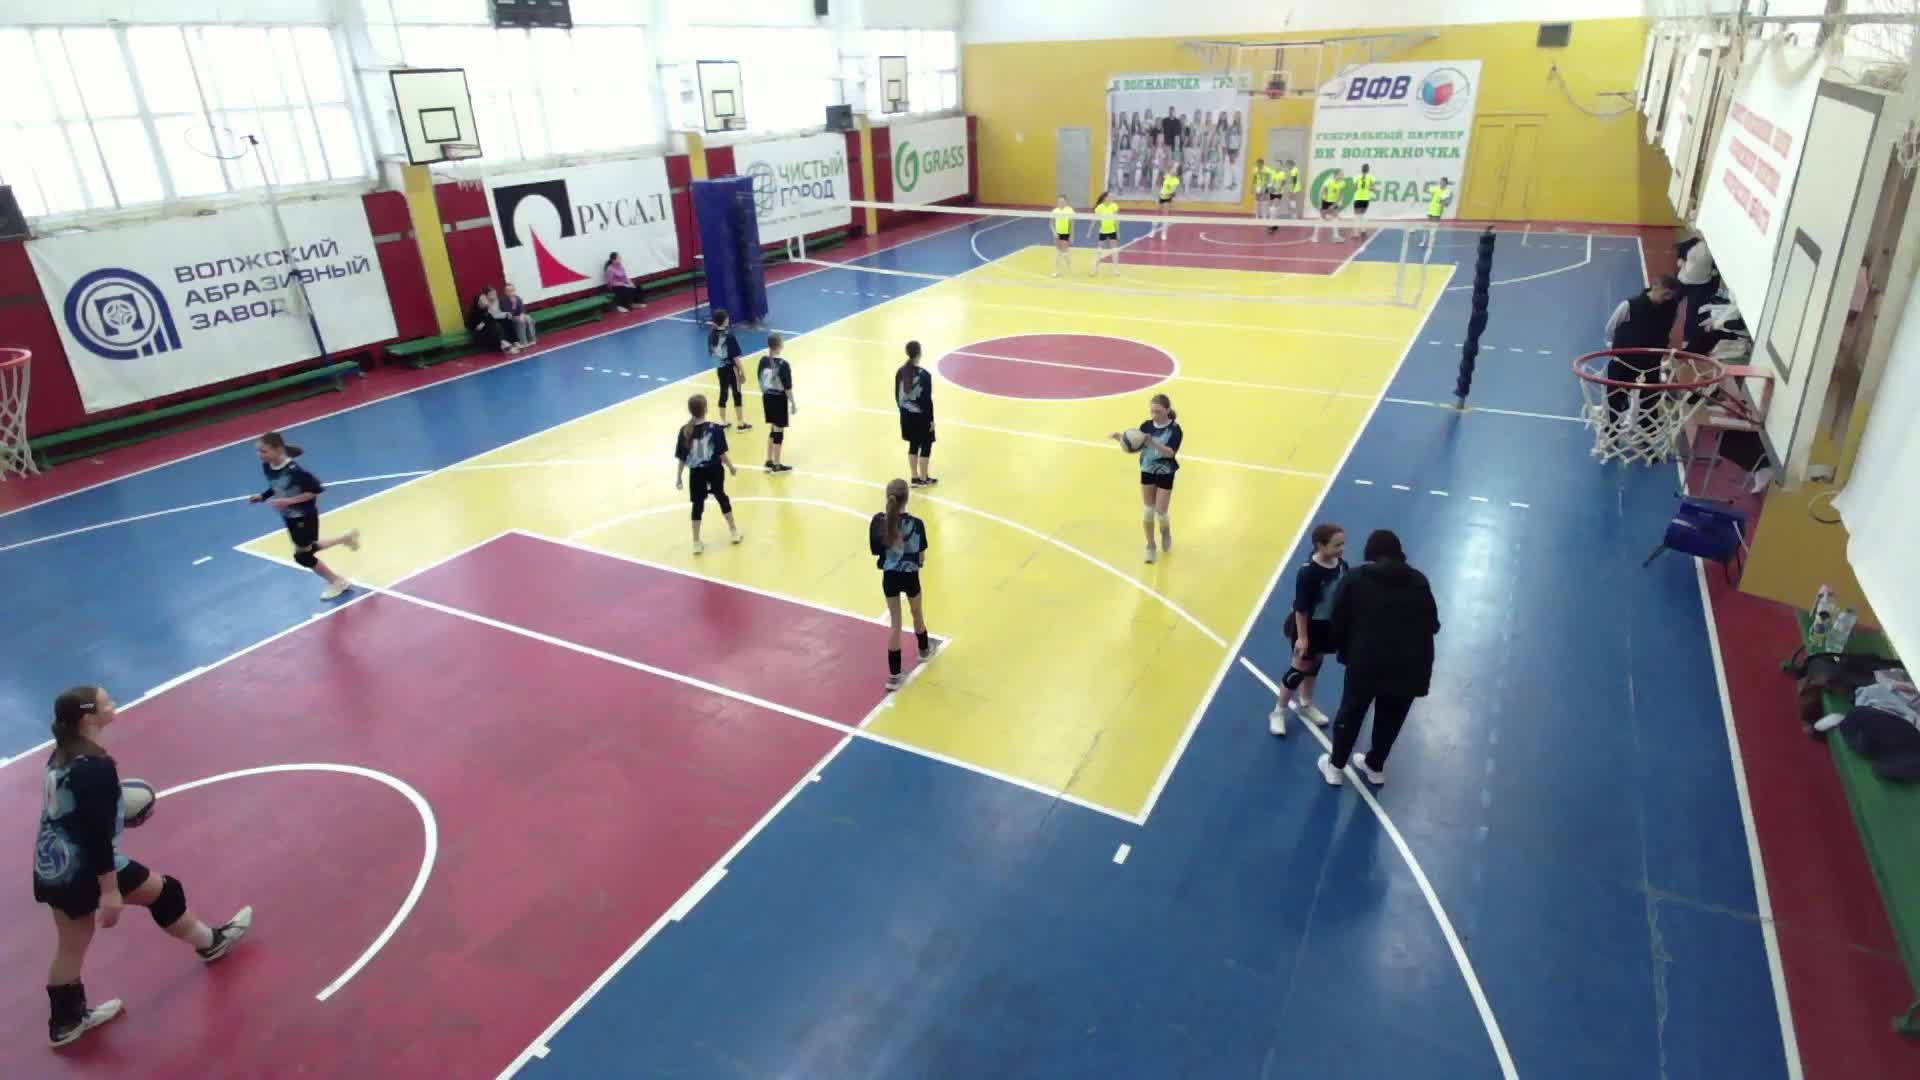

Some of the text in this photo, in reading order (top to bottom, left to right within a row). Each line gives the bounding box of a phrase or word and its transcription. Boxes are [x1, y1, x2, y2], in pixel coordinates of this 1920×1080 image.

[1346, 75, 1411, 101] ВФВ
[1316, 130, 1464, 140] ГЕНЕРАЛЬНЫЙ ПАРТНЕР
[922, 145, 965, 174] GRASS
[1341, 146, 1461, 159] ВОЛЖАНОЧКА
[777, 150, 844, 184] ЧИСТЫЙ
[780, 179, 835, 207] ГОРОД
[1370, 180, 1456, 203] GRAS
[577, 193, 666, 235] РУСАЛ
[174, 237, 340, 284] ВОЛЖСКИЙ
[184, 255, 371, 308] АБРАЗИВНЫЙ
